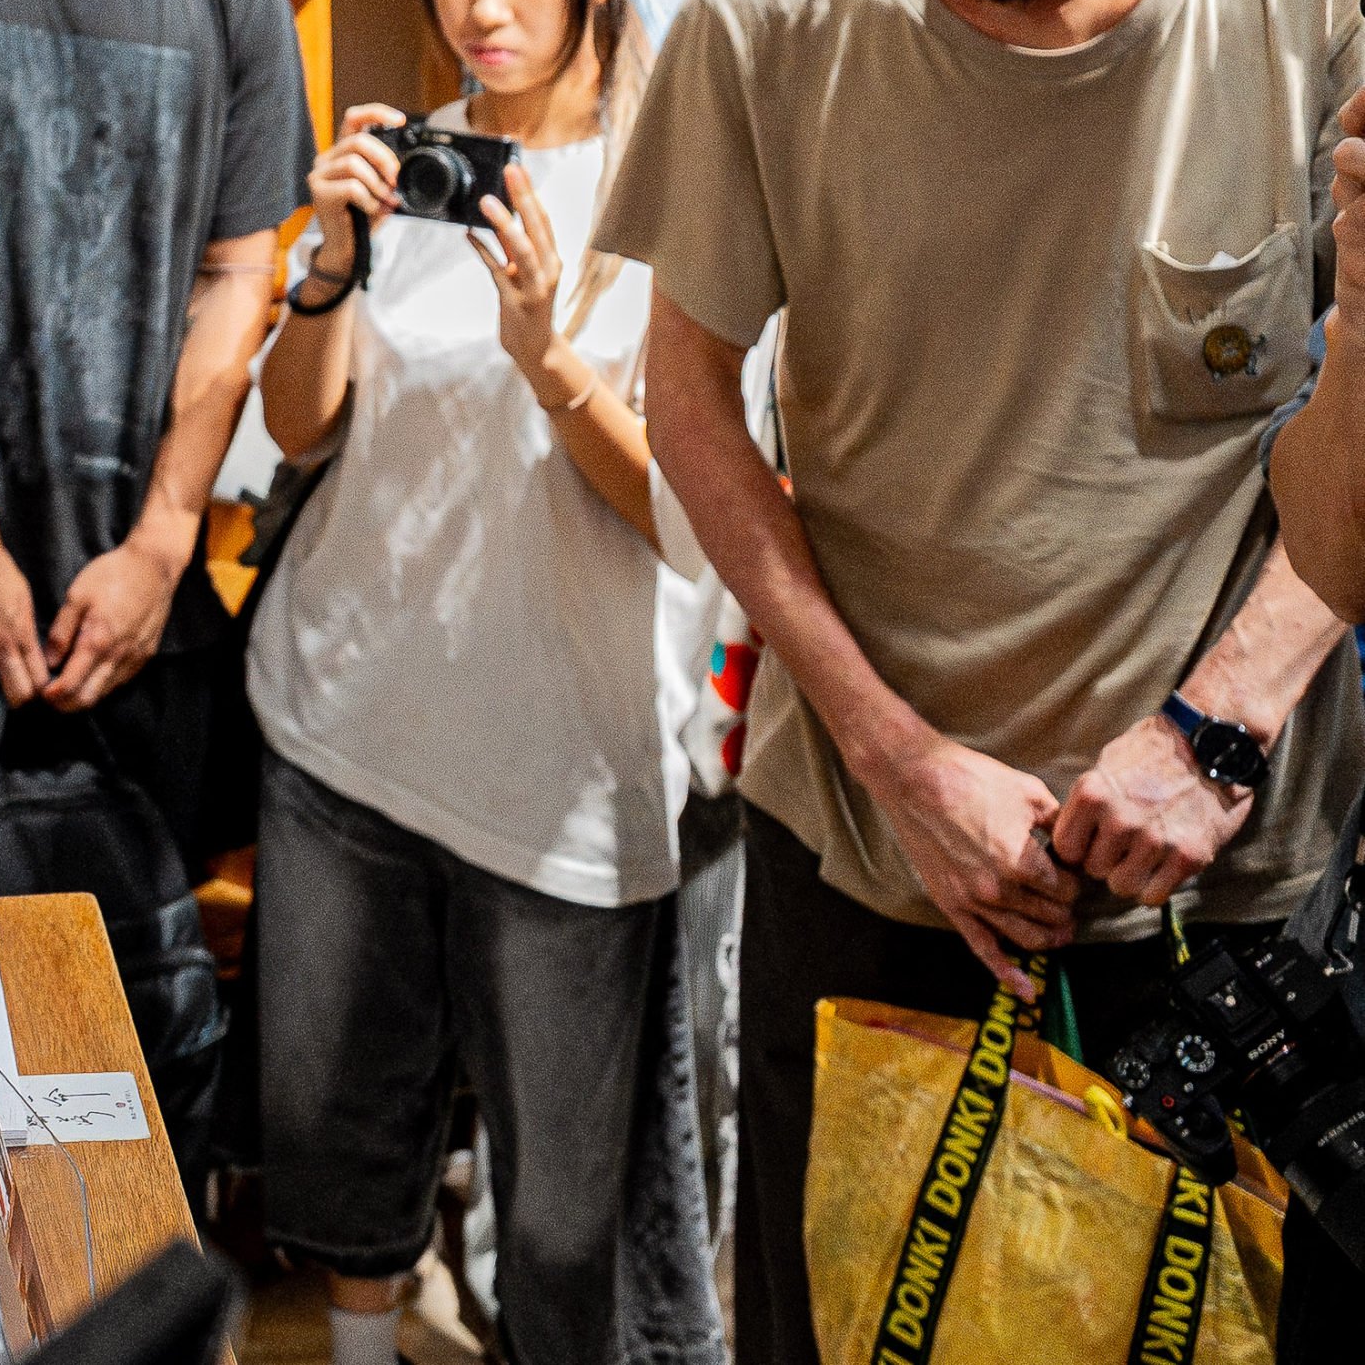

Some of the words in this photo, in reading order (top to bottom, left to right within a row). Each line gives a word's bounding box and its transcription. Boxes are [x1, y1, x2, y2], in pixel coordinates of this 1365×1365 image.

[1247, 1028, 1286, 1062] SONY
[924, 1087, 996, 1219] DONKI
[887, 1216, 952, 1350] DONKI
[1139, 1234, 1205, 1365] DONKI
